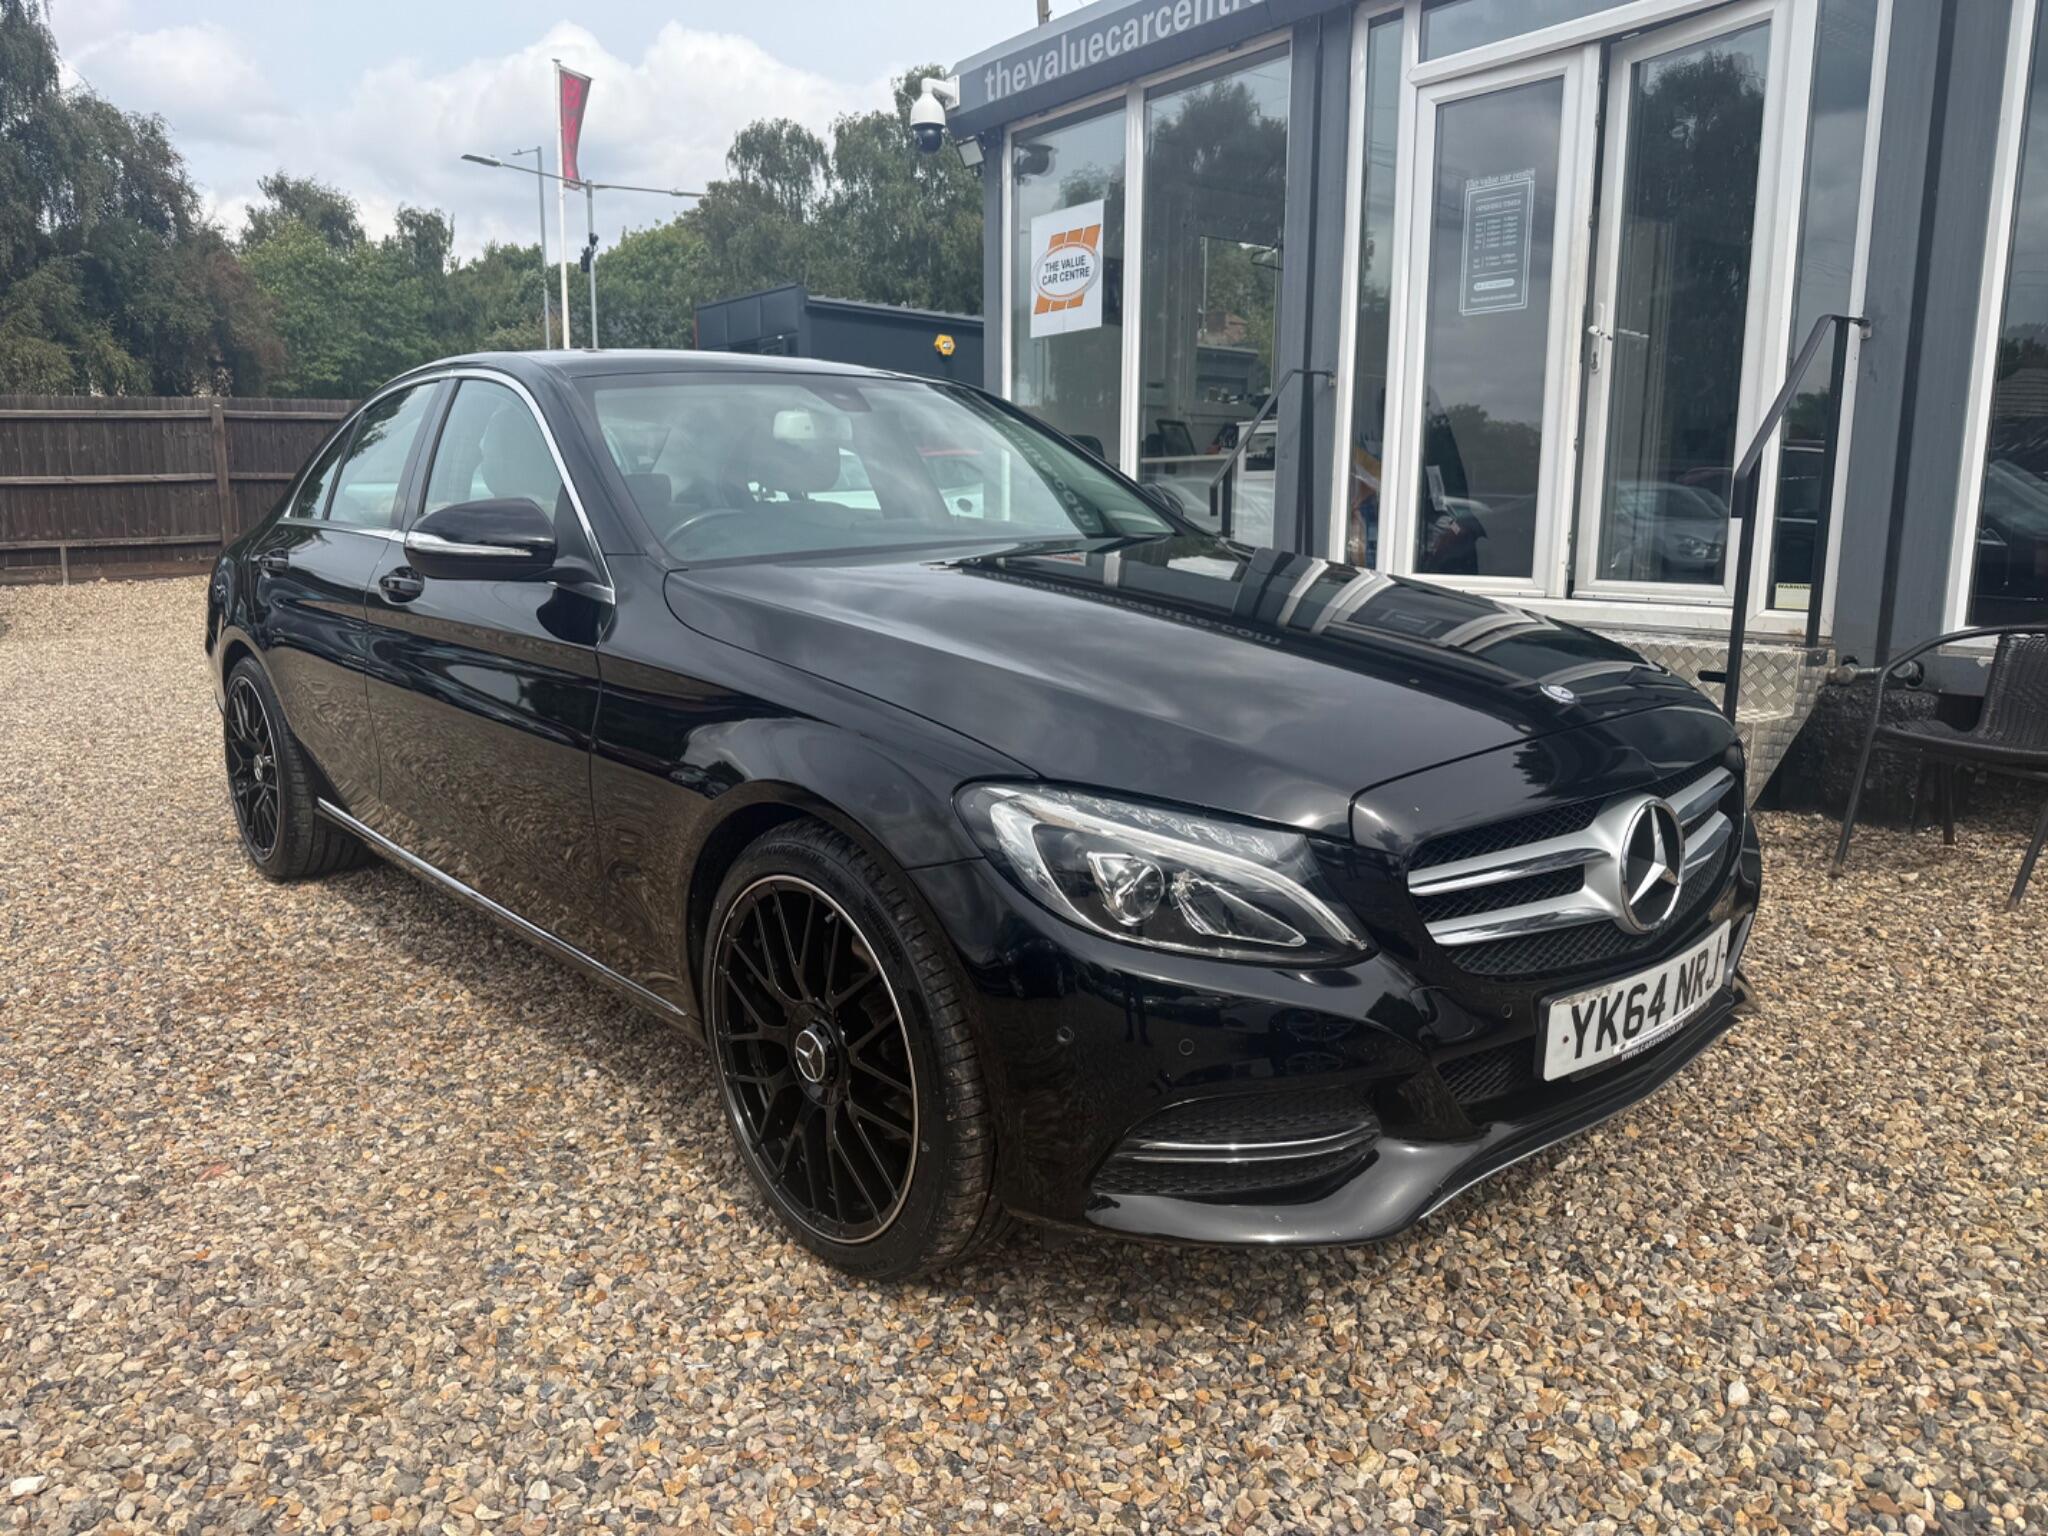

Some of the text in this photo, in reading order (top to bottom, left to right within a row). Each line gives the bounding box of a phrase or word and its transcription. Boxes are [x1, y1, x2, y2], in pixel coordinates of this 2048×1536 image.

[1045, 255, 1086, 273] THE VALUE
[1042, 266, 1090, 286] CAR CENTRE
[1571, 972, 1667, 1060] YK64
[1673, 935, 1722, 1016] NRJ
